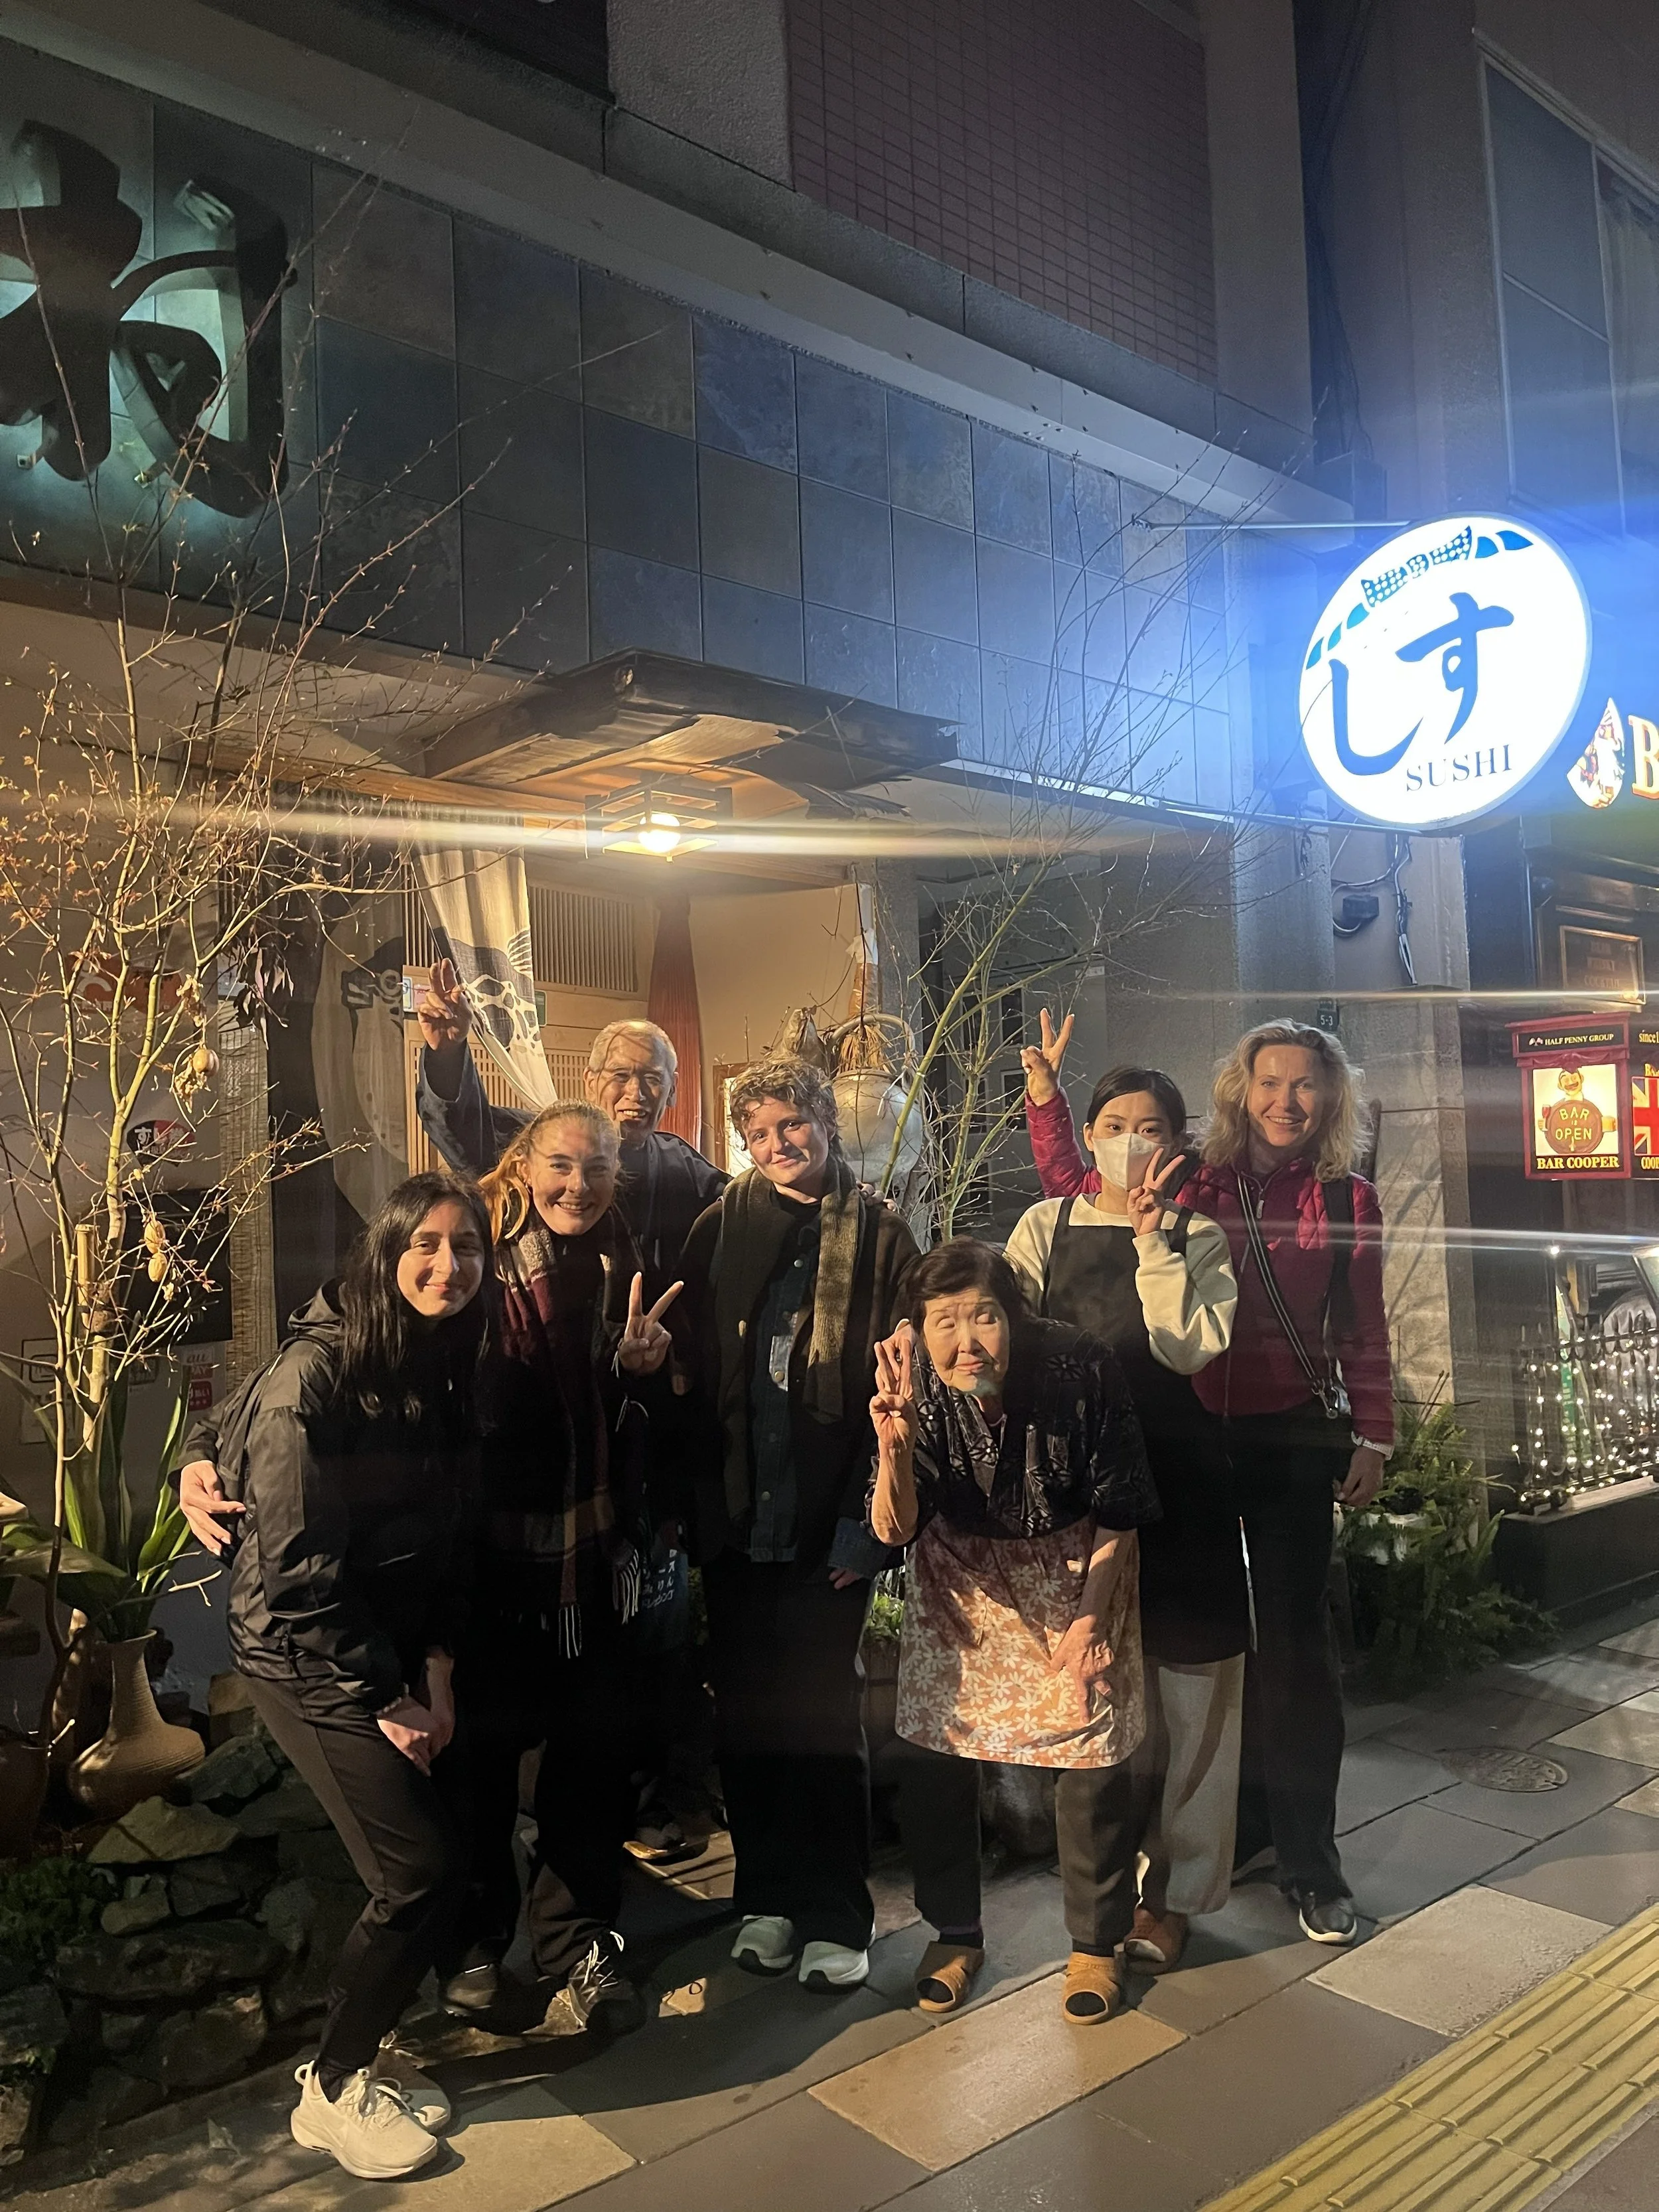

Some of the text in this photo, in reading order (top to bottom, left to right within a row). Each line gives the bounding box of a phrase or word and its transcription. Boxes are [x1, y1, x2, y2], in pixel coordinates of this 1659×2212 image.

[1406, 744, 1512, 792] SUSHI
[1320, 1014, 1333, 1026] 5-3
[1545, 1033, 1615, 1046] HALF PENNY GROUP
[1559, 1106, 1590, 1121] BAR
[1555, 1128, 1592, 1140] OPEN
[1537, 1155, 1620, 1169] BAR COOPER
[186, 1353, 207, 1363] au
